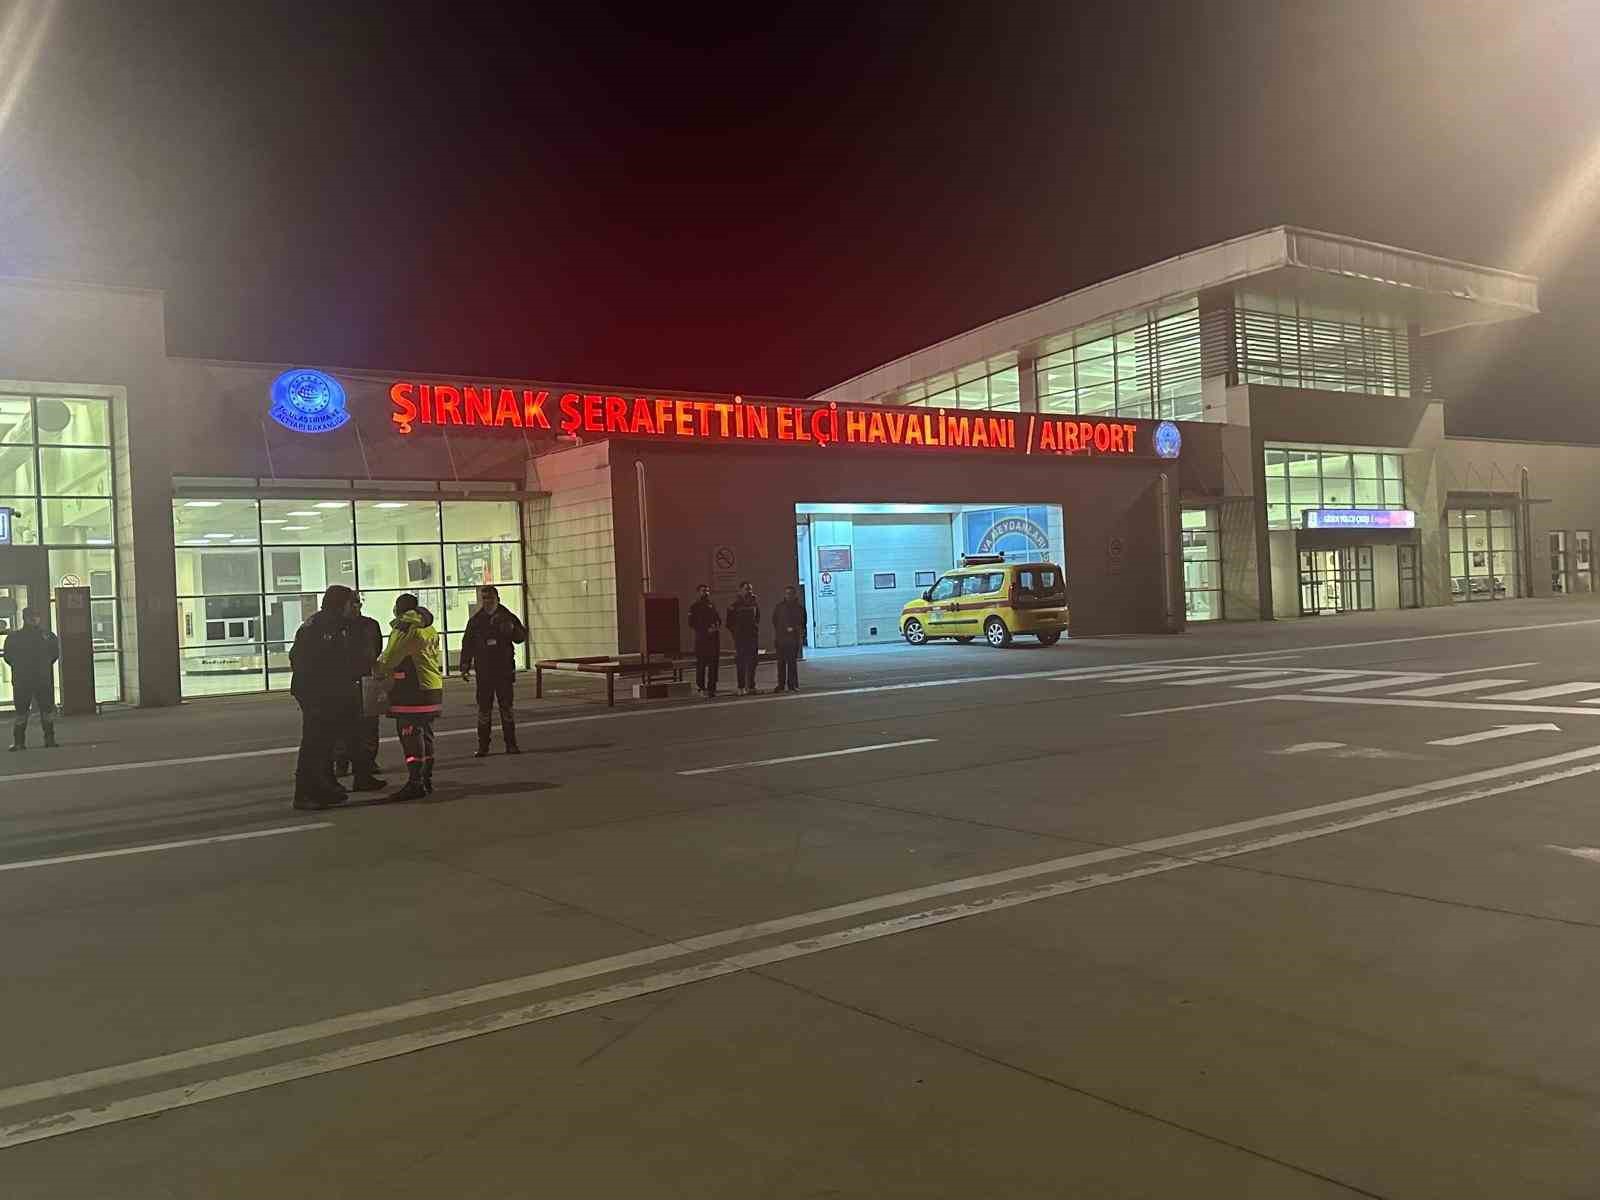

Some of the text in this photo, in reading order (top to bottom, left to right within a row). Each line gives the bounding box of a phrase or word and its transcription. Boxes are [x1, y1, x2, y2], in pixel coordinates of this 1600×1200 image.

[390, 382, 551, 434] ŞIRNAK
[559, 393, 769, 439] ŞERAFETTİN
[776, 401, 839, 448] ELÇİ
[846, 408, 1016, 449] HAVALİMANI
[1026, 415, 1035, 455] /
[1040, 419, 1137, 453] AIRPORT
